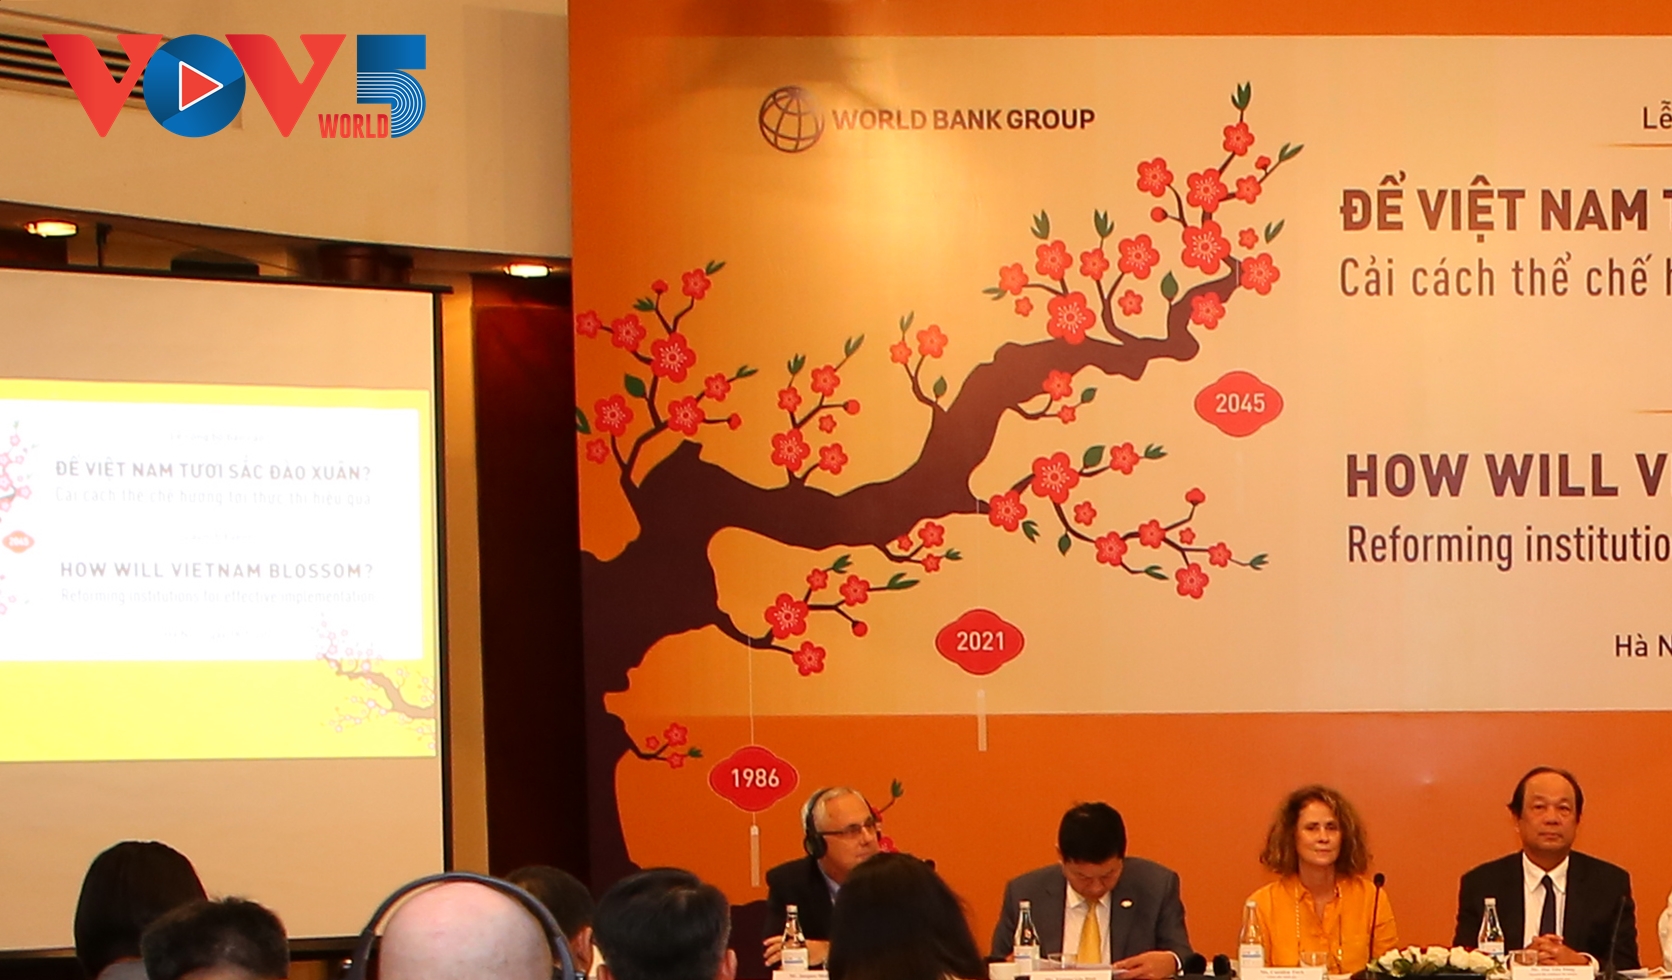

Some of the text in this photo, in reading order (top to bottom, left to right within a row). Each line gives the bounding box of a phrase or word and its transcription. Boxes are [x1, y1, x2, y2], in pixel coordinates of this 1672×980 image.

[832, 108, 1095, 130] WORLD BANK GROUP
[1340, 170, 1406, 231] ĐỂ
[1417, 175, 1525, 243] VIỆT
[1541, 189, 1647, 231] NAM
[1341, 255, 1393, 296] Cải
[1413, 257, 1494, 296] cách
[1512, 251, 1571, 296] thể
[1587, 254, 1652, 296] chế
[1216, 393, 1265, 412] 2045
[132, 463, 173, 478] NAM
[1347, 454, 1469, 497] HOW
[1485, 453, 1618, 497] WILL
[1349, 525, 1512, 572] Reforming
[61, 562, 373, 579] HOW WILL VIETNAM BLOSSOM?
[957, 631, 1003, 650] 2021
[1616, 633, 1647, 657] Hà
[732, 768, 779, 787] 1986
